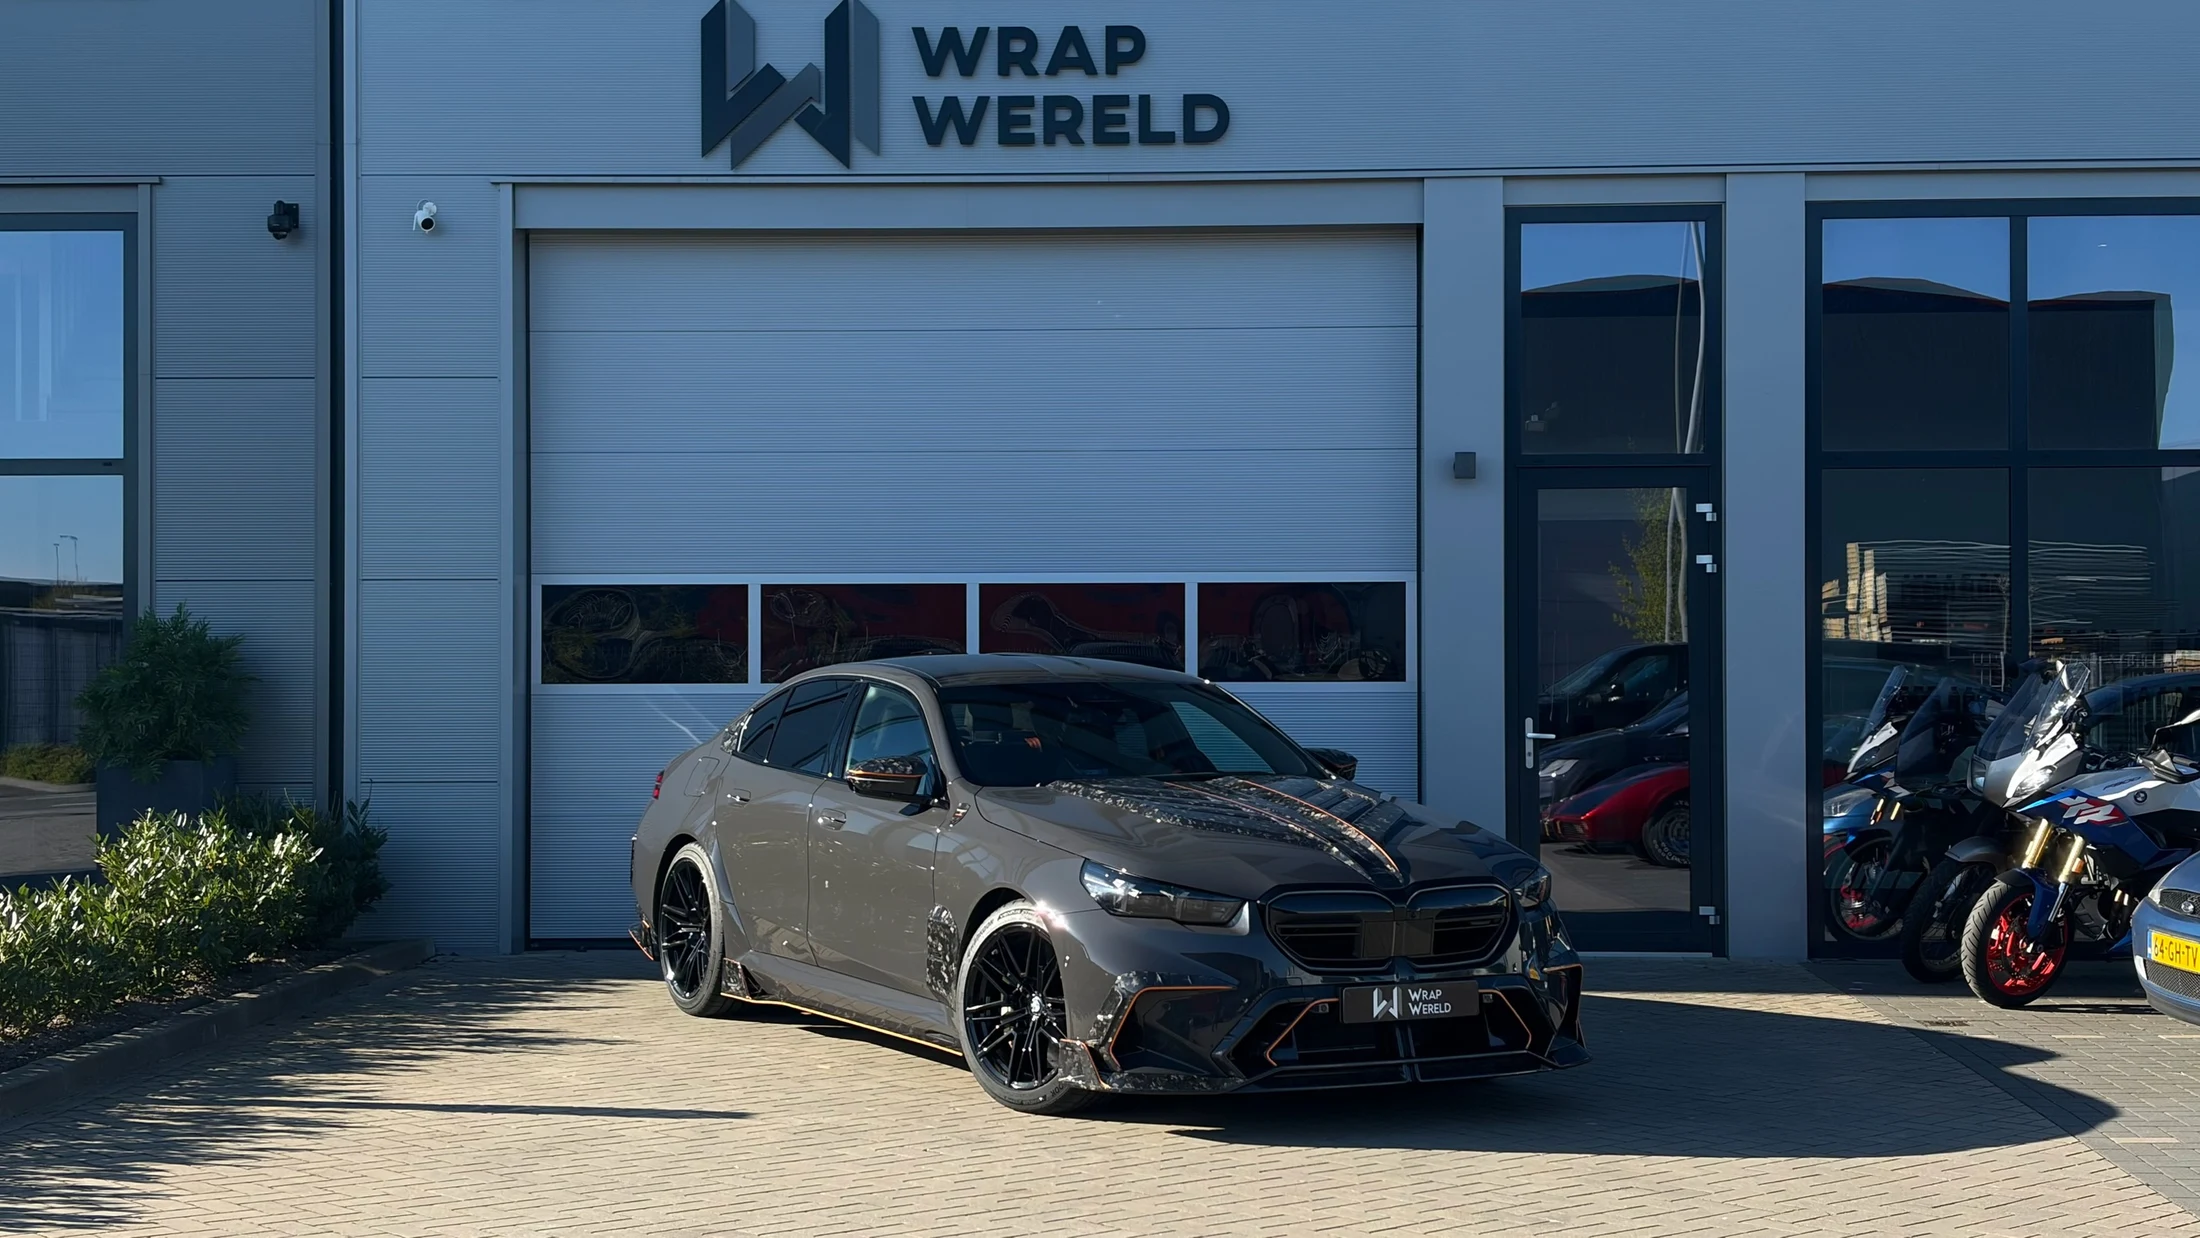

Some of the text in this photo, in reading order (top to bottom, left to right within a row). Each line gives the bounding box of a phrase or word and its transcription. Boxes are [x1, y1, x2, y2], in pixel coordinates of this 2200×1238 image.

[911, 25, 1147, 77] WRAP
[911, 93, 1231, 146] WERELD
[2154, 937, 2198, 968] 64-GH-TV
